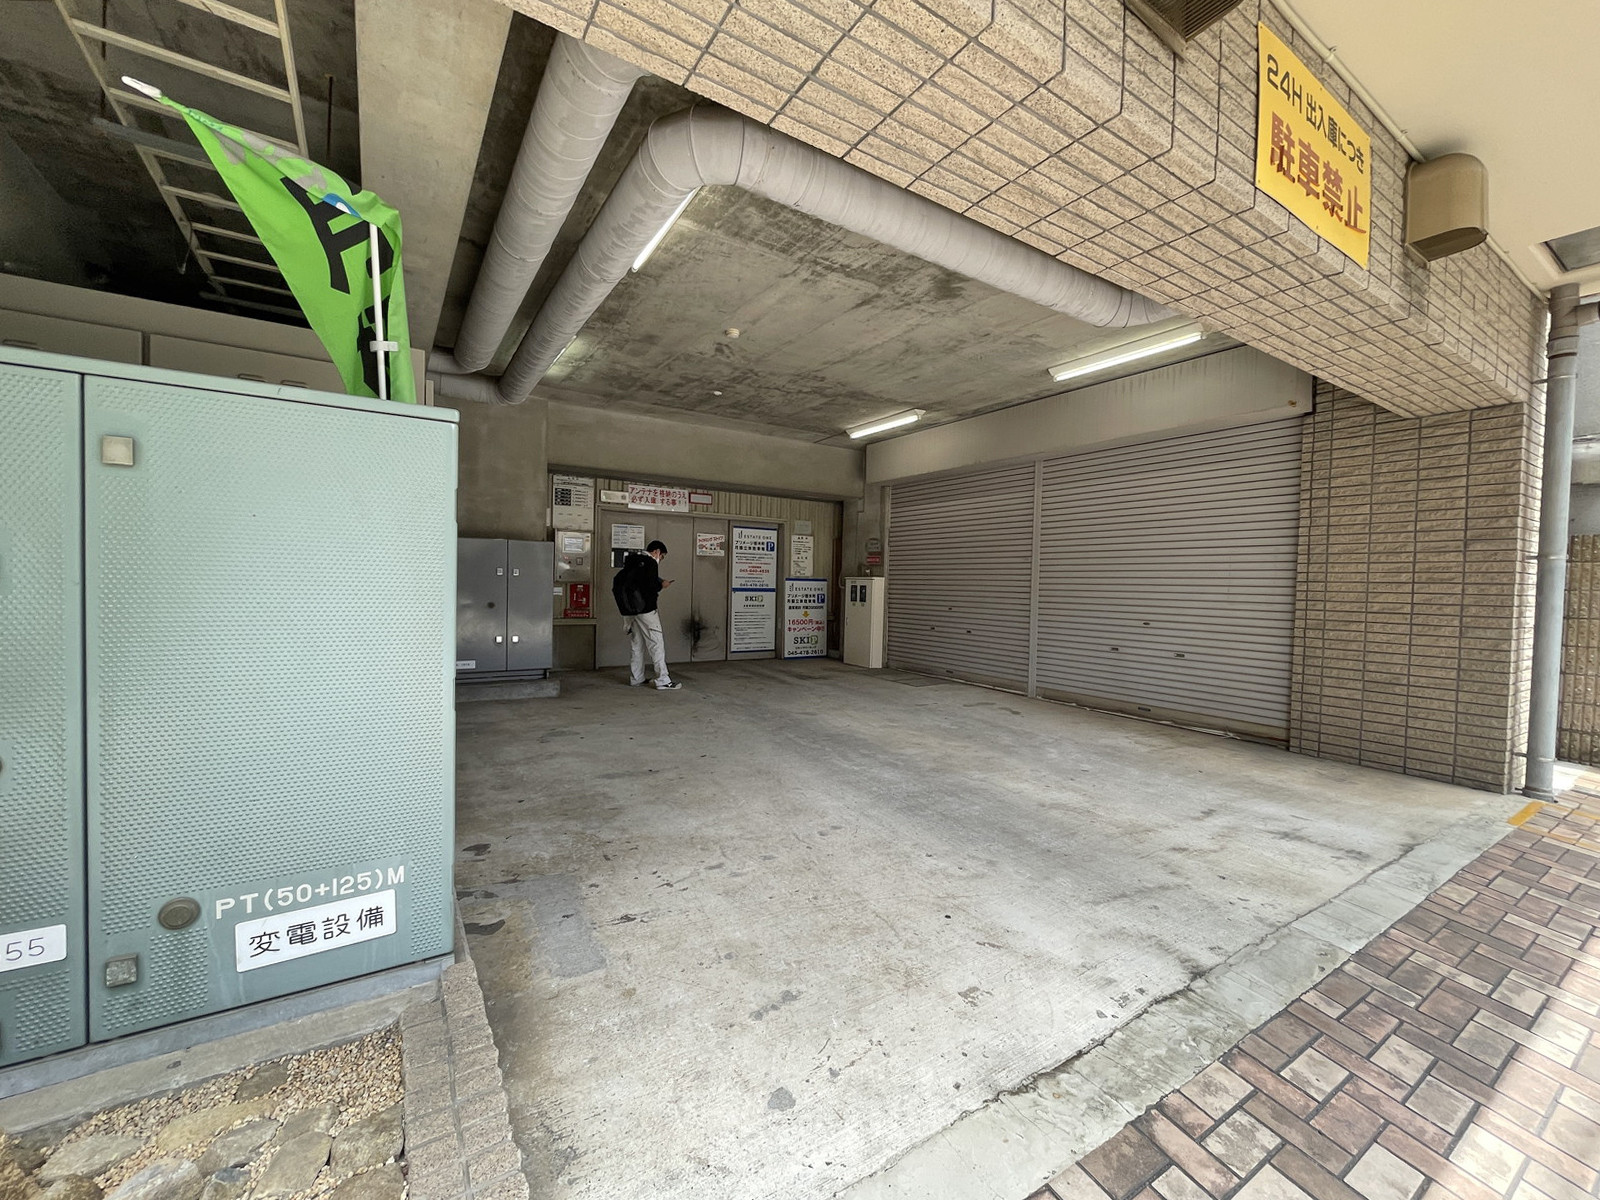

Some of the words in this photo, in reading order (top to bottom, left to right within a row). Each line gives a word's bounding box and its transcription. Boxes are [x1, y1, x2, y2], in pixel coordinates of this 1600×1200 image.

[1269, 111, 1367, 234] 駐車禁止
[793, 635, 819, 645] SKIP
[249, 905, 385, 958] 変電設備
